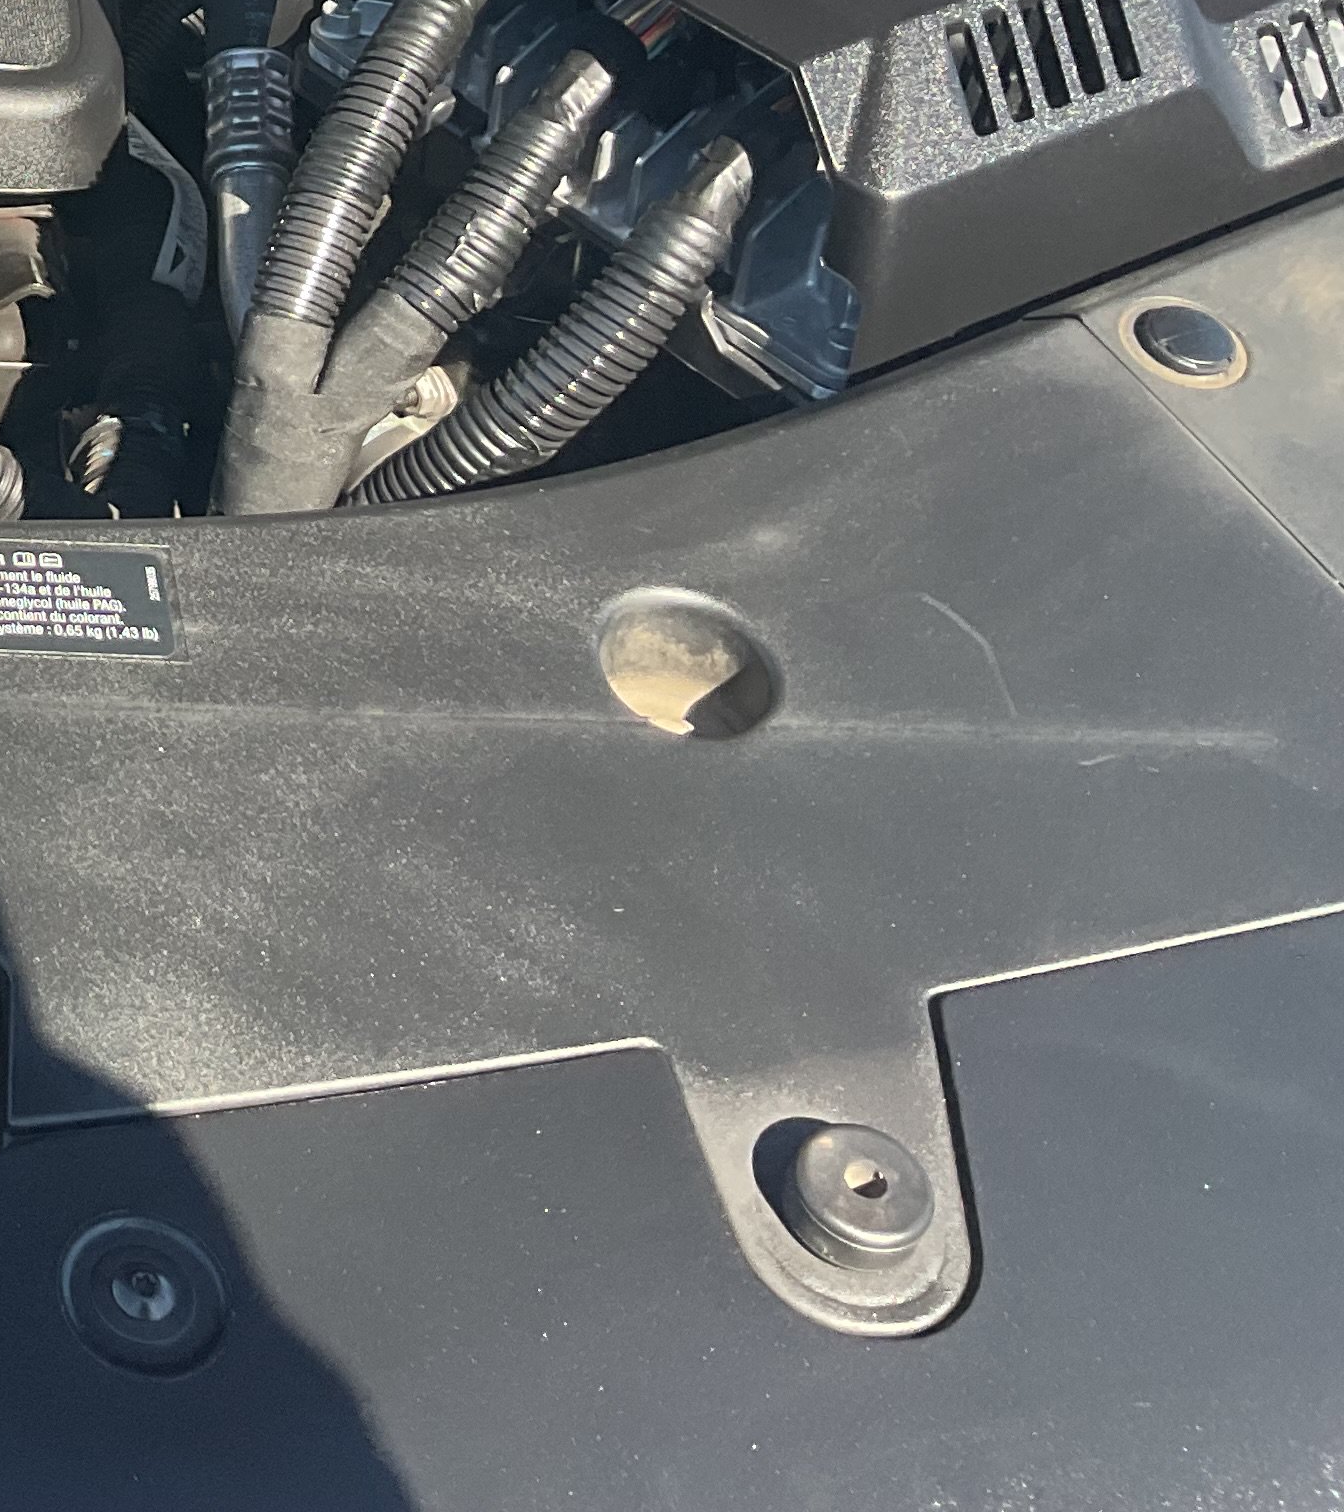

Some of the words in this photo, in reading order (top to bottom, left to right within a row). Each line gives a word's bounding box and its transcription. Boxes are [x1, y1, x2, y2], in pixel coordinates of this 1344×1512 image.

[31, 570, 43, 582] le
[45, 570, 81, 584] fluide
[38, 585, 52, 596] et
[54, 585, 71, 597] de
[55, 598, 90, 611] (huile
[49, 610, 67, 623] du
[86, 625, 103, 639] kg
[142, 626, 160, 642] lb)
